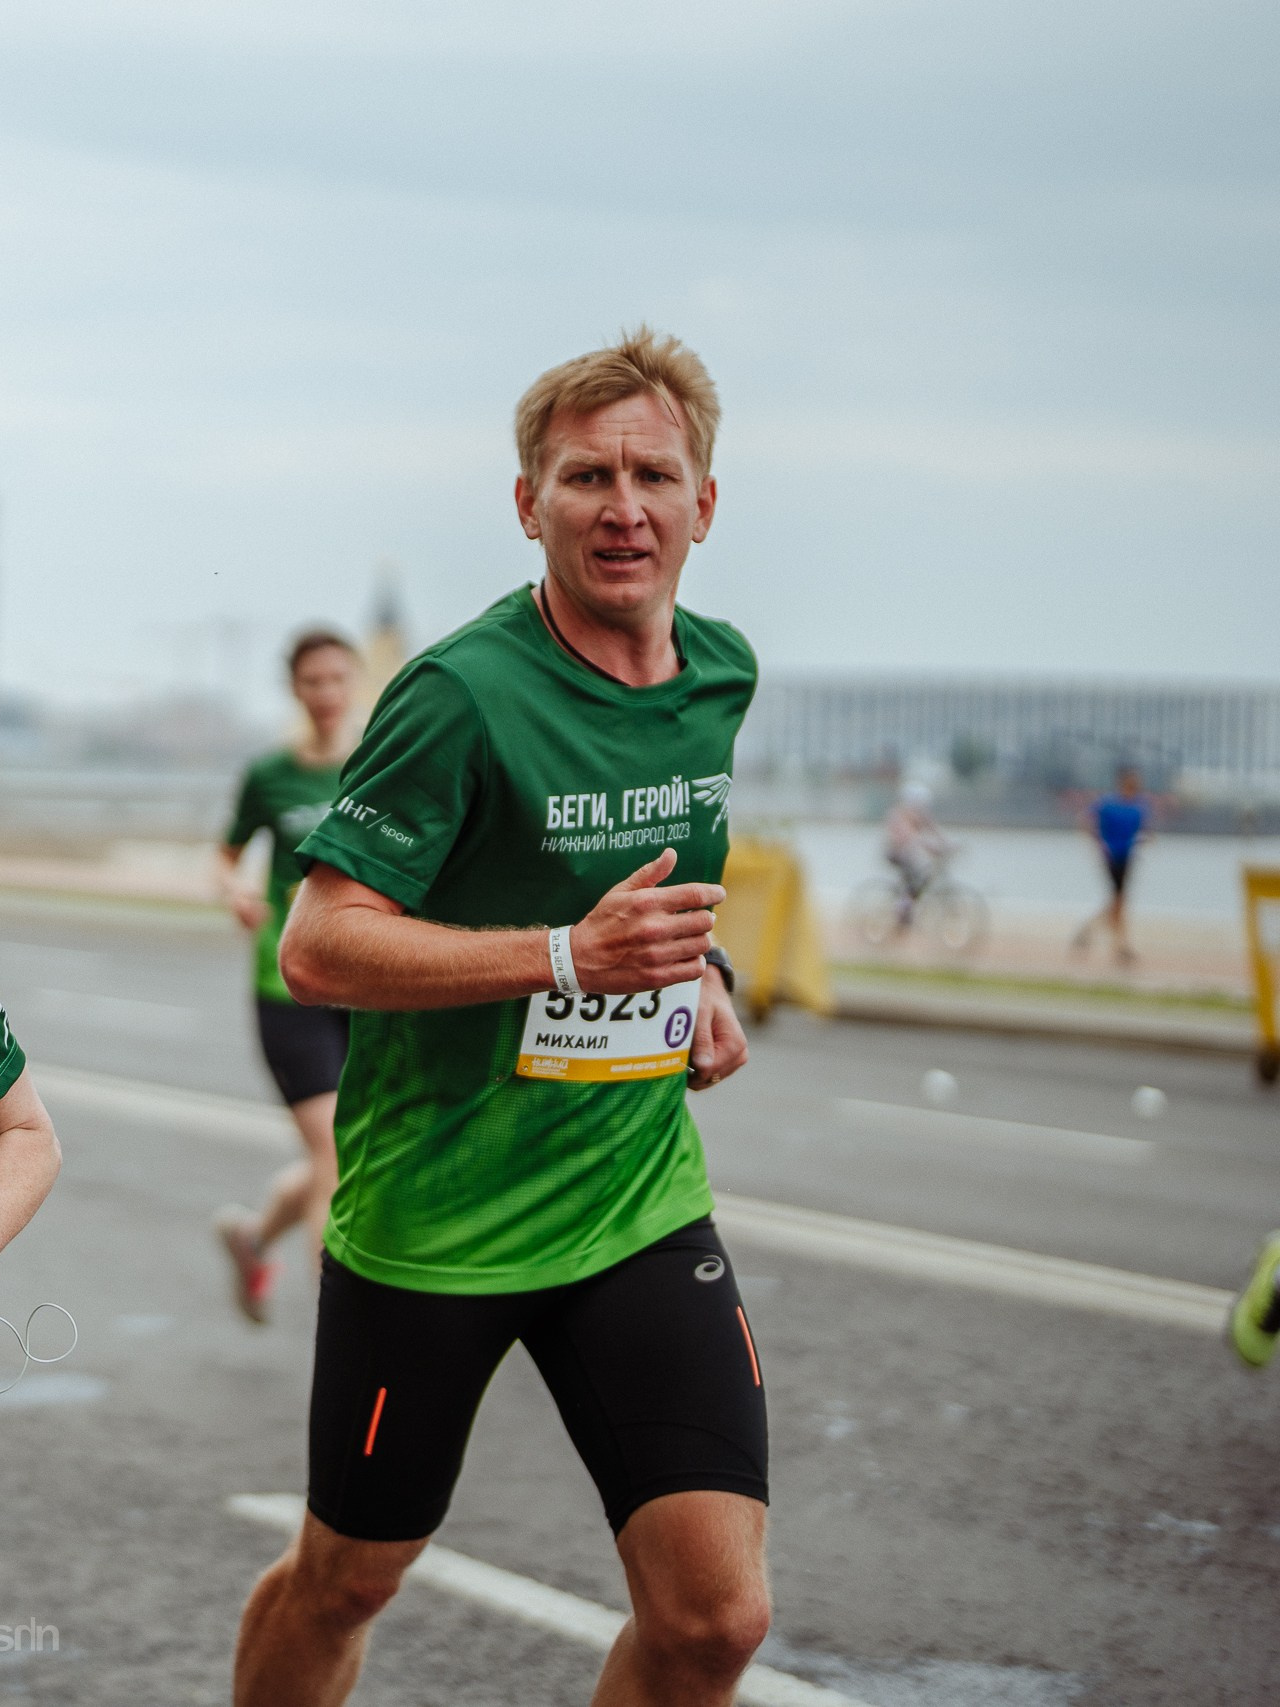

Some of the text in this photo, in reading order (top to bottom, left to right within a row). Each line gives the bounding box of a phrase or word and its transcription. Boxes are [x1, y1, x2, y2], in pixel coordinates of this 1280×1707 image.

[546, 775, 690, 831] БЕГИ, ГЕРОЙ!
[541, 822, 690, 852] НИЖНИЙ НОВГОРОД 2023
[545, 988, 663, 1022] 5523
[535, 1033, 609, 1049] МИХАИЛ
